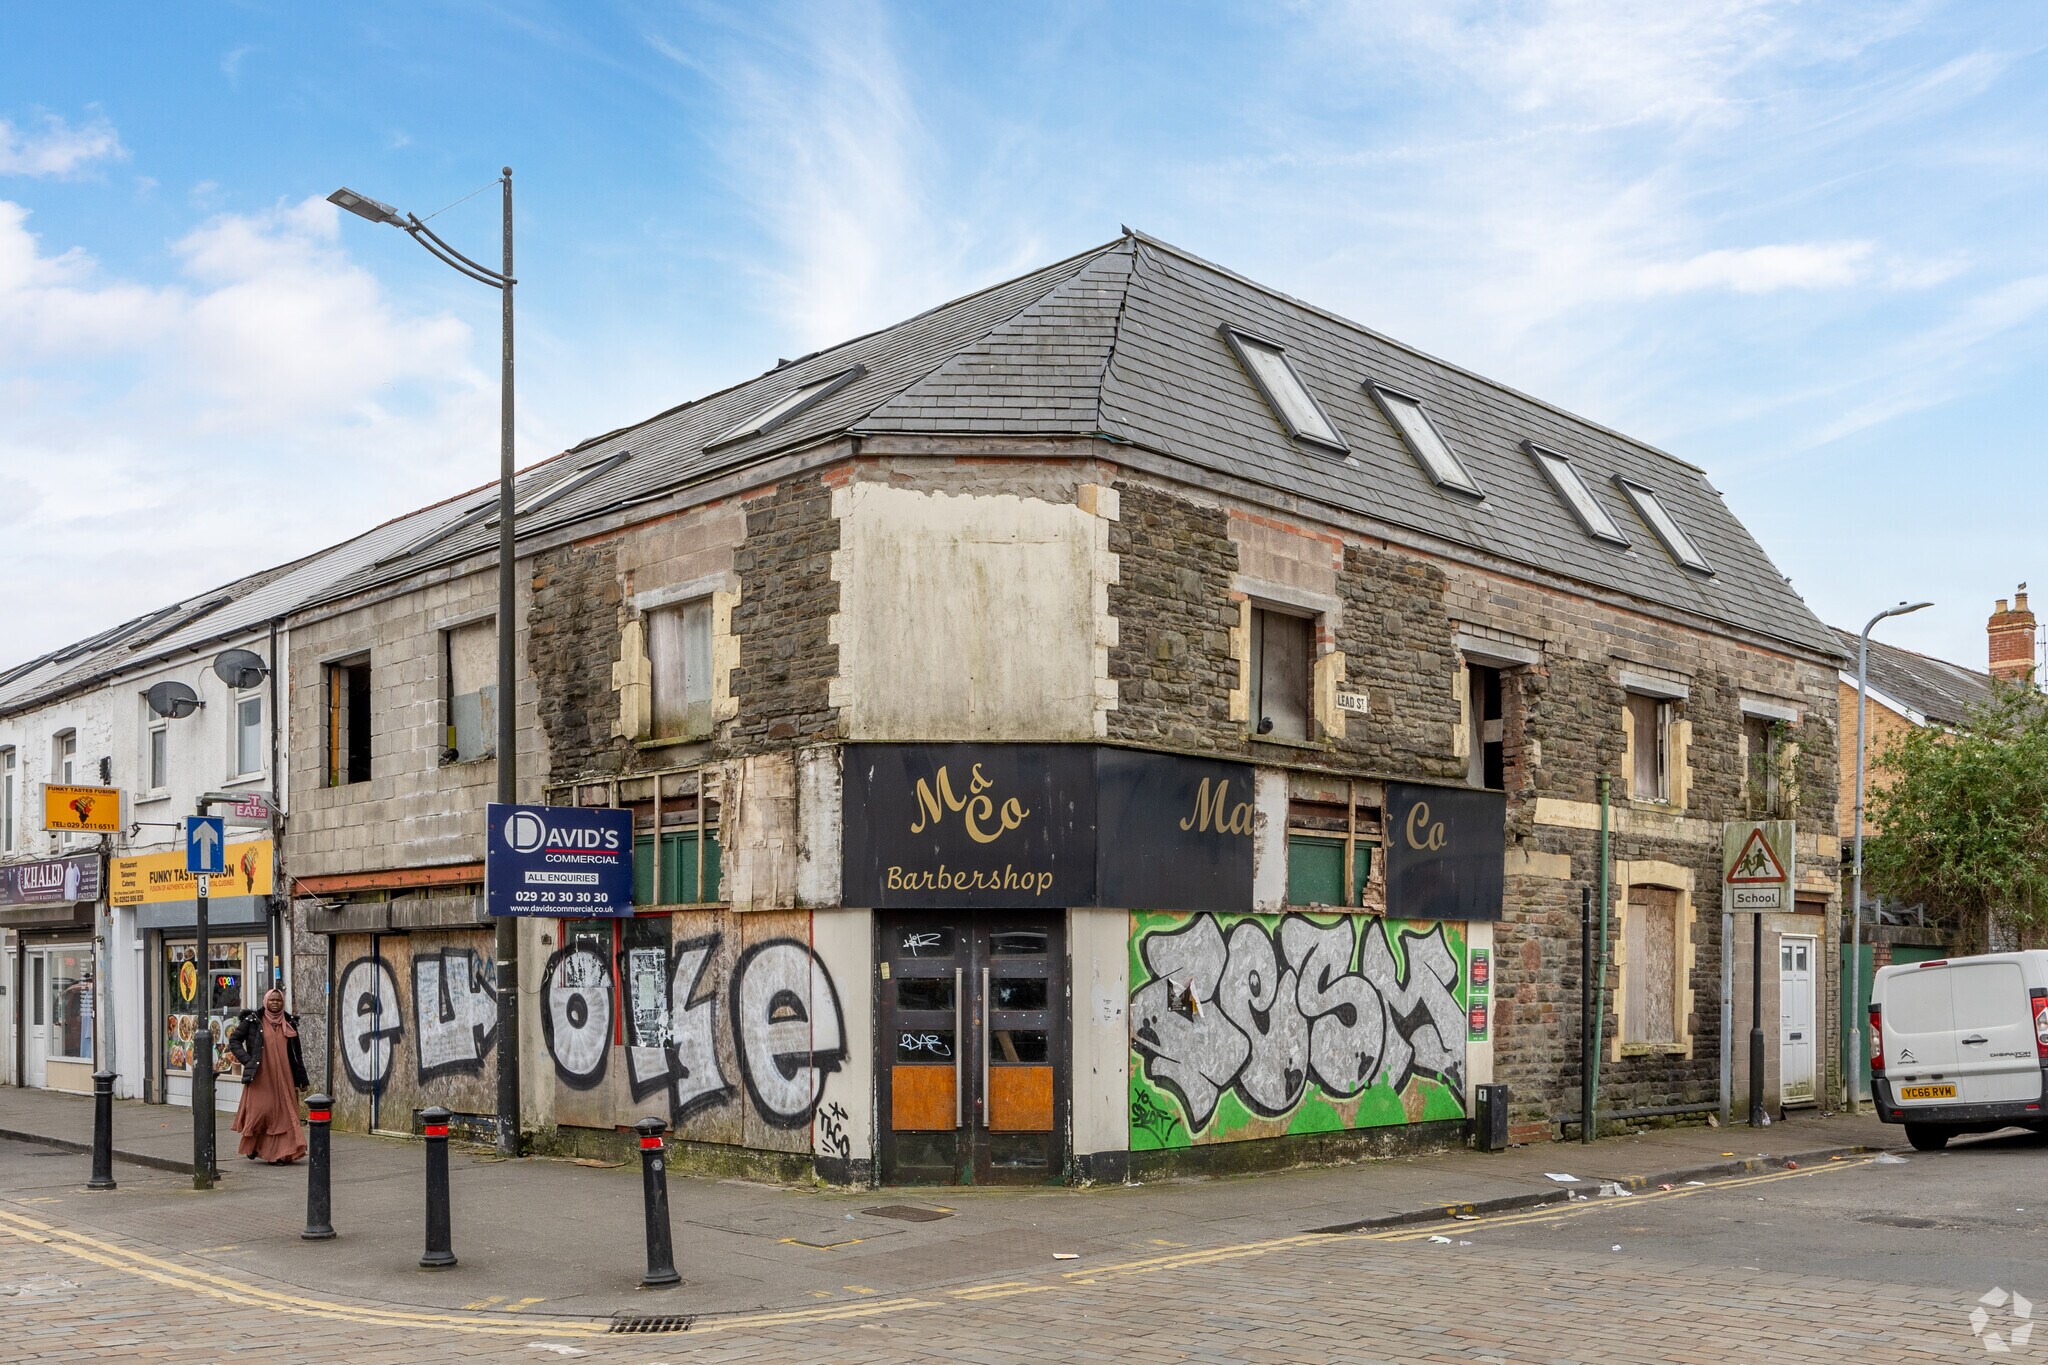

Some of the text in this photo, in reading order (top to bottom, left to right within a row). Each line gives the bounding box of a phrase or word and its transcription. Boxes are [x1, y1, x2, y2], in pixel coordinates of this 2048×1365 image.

[1337, 694, 1354, 708] LEAD
[236, 806, 259, 816] EAT
[1406, 801, 1448, 851] Co
[505, 811, 619, 853] DAVID'S
[545, 854, 619, 864] COMMERCIAL
[23, 863, 64, 889] KHALED
[149, 869, 172, 884] FUNKY
[527, 873, 597, 883] ALL ENQUIRIES
[887, 864, 1053, 896] Barbershop
[515, 891, 609, 903] 029 20 30 30 30
[1737, 893, 1776, 903] School
[510, 905, 614, 913] www.davidscommercial.co.uk
[1480, 1090, 1485, 1100] 1
[1905, 1088, 1931, 1098] YC66
